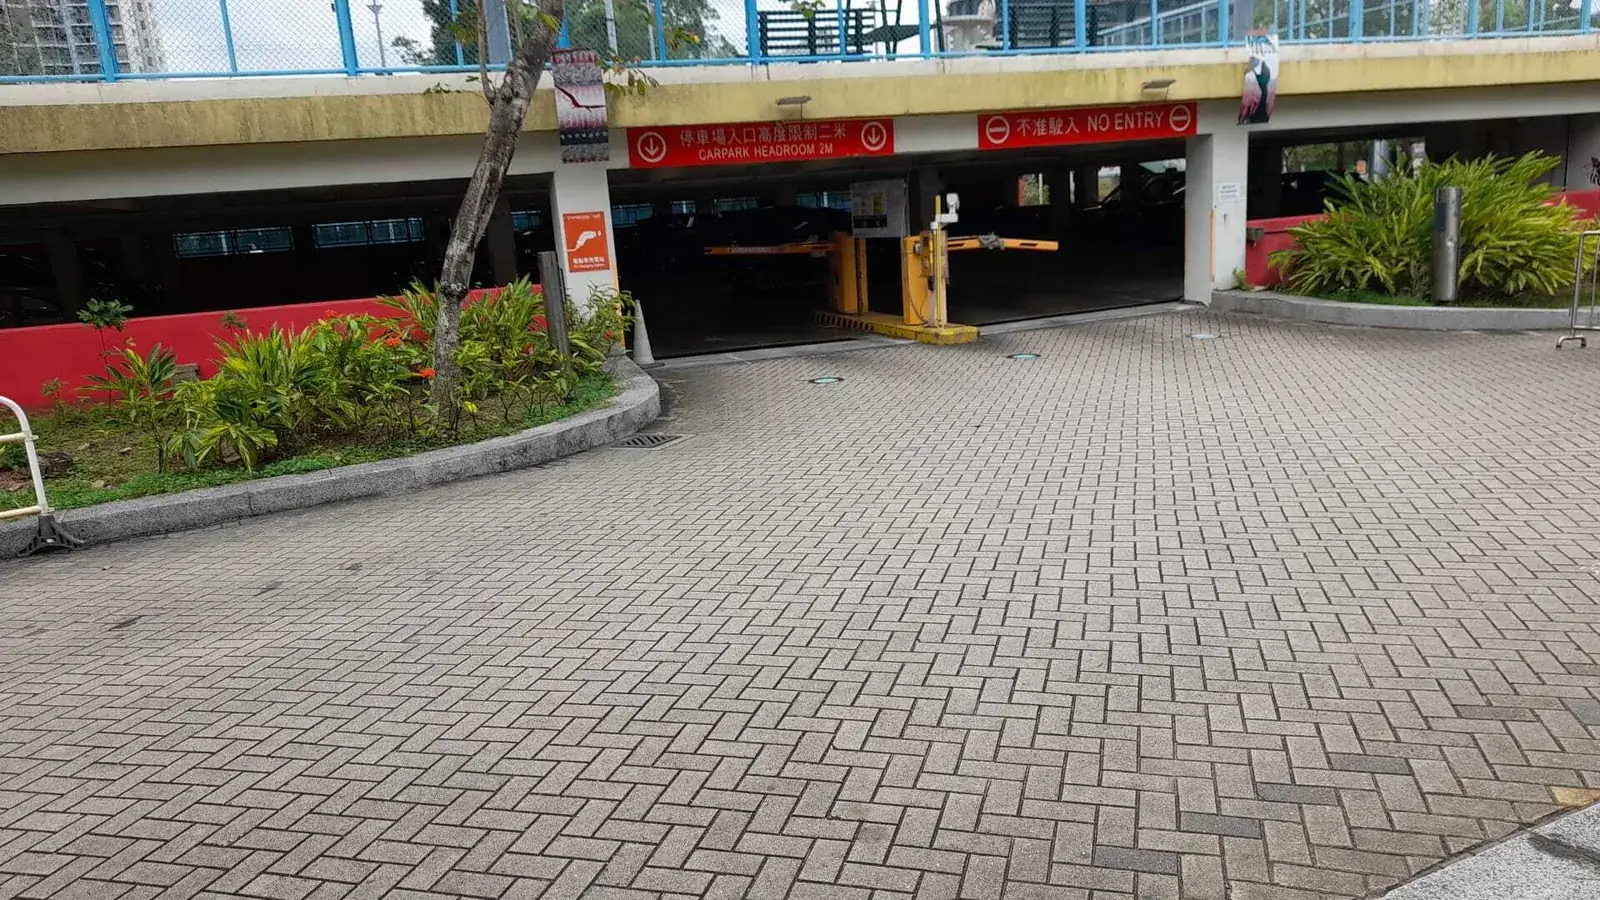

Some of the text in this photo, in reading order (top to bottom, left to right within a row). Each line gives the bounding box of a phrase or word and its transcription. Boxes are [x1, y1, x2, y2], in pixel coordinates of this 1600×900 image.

[1016, 110, 1164, 137] 不准駛入 NO ENTRY
[680, 124, 846, 147] 停車場入口高度限制二米
[698, 143, 833, 161] CARPARK HEADROOM 2M
